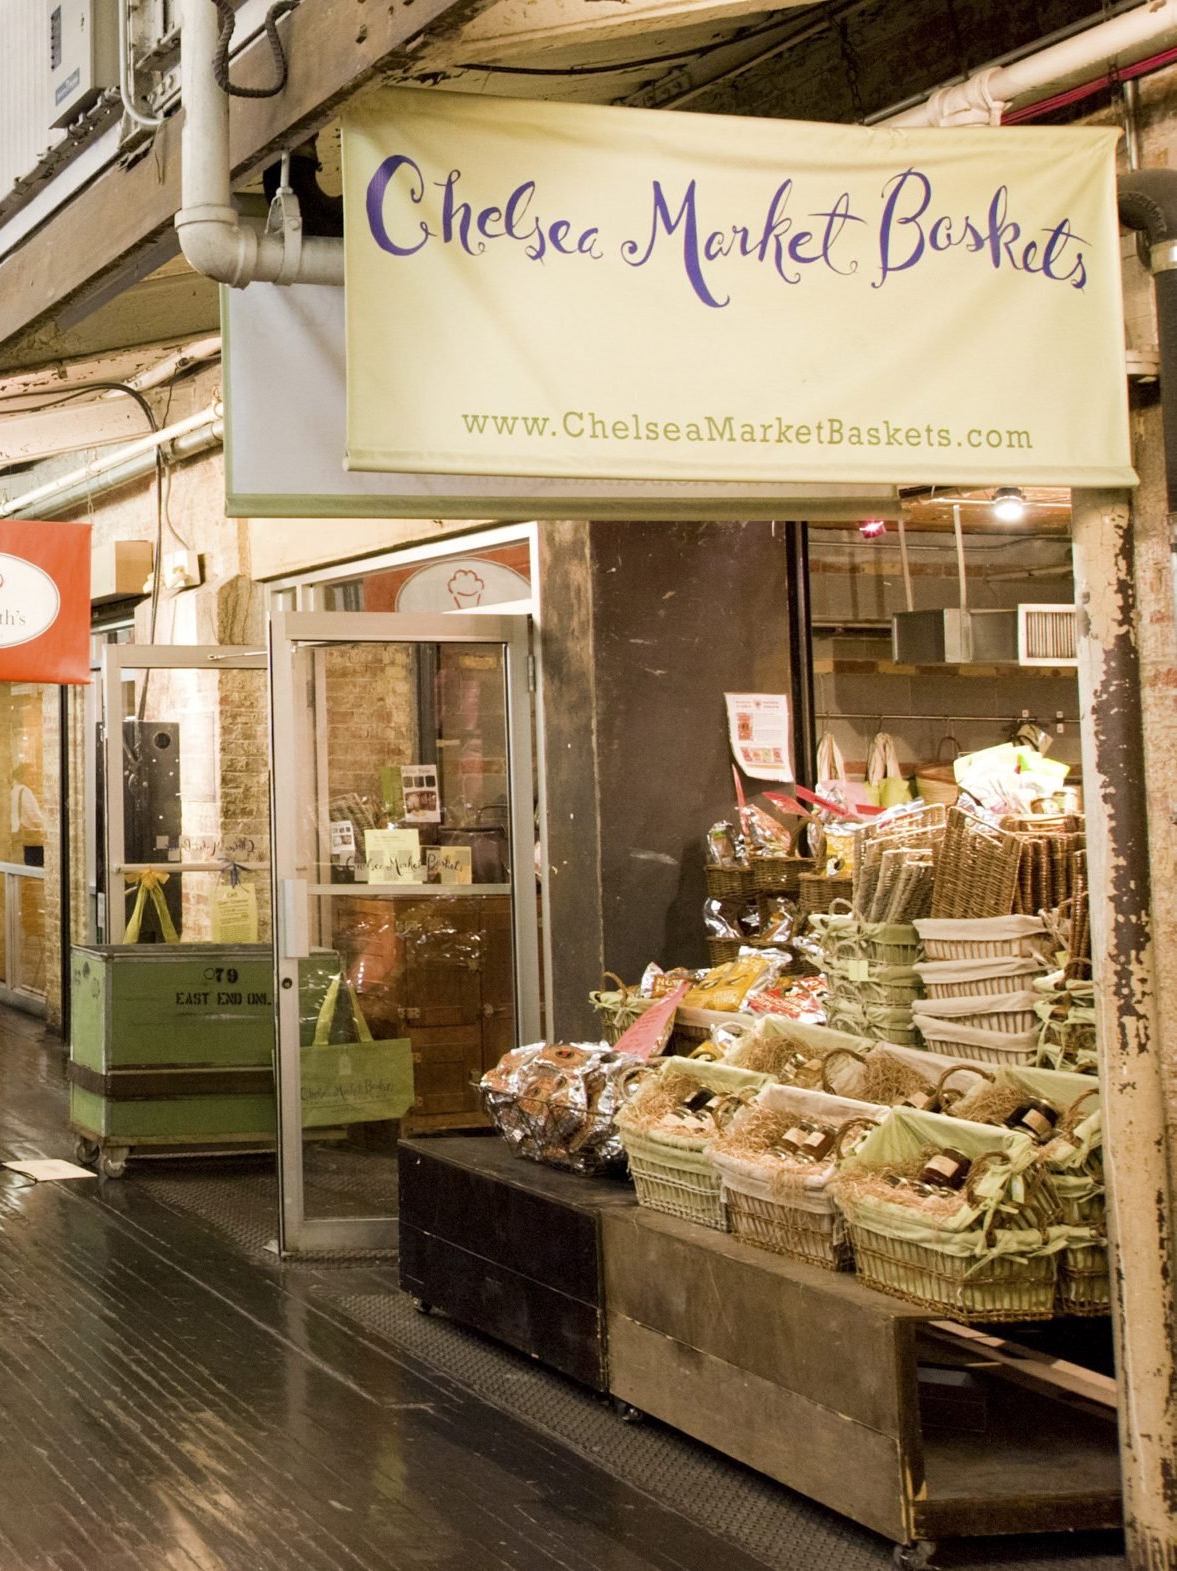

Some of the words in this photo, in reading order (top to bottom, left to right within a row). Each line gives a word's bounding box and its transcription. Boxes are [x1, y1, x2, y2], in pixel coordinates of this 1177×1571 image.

[366, 155, 603, 266] Chelsea
[621, 178, 868, 308] Market
[871, 166, 1092, 294] Baskets
[462, 410, 1033, 449] www.ChelseaMarketBaskets.com
[176, 993, 209, 1005] EAST
[217, 993, 242, 1005] END
